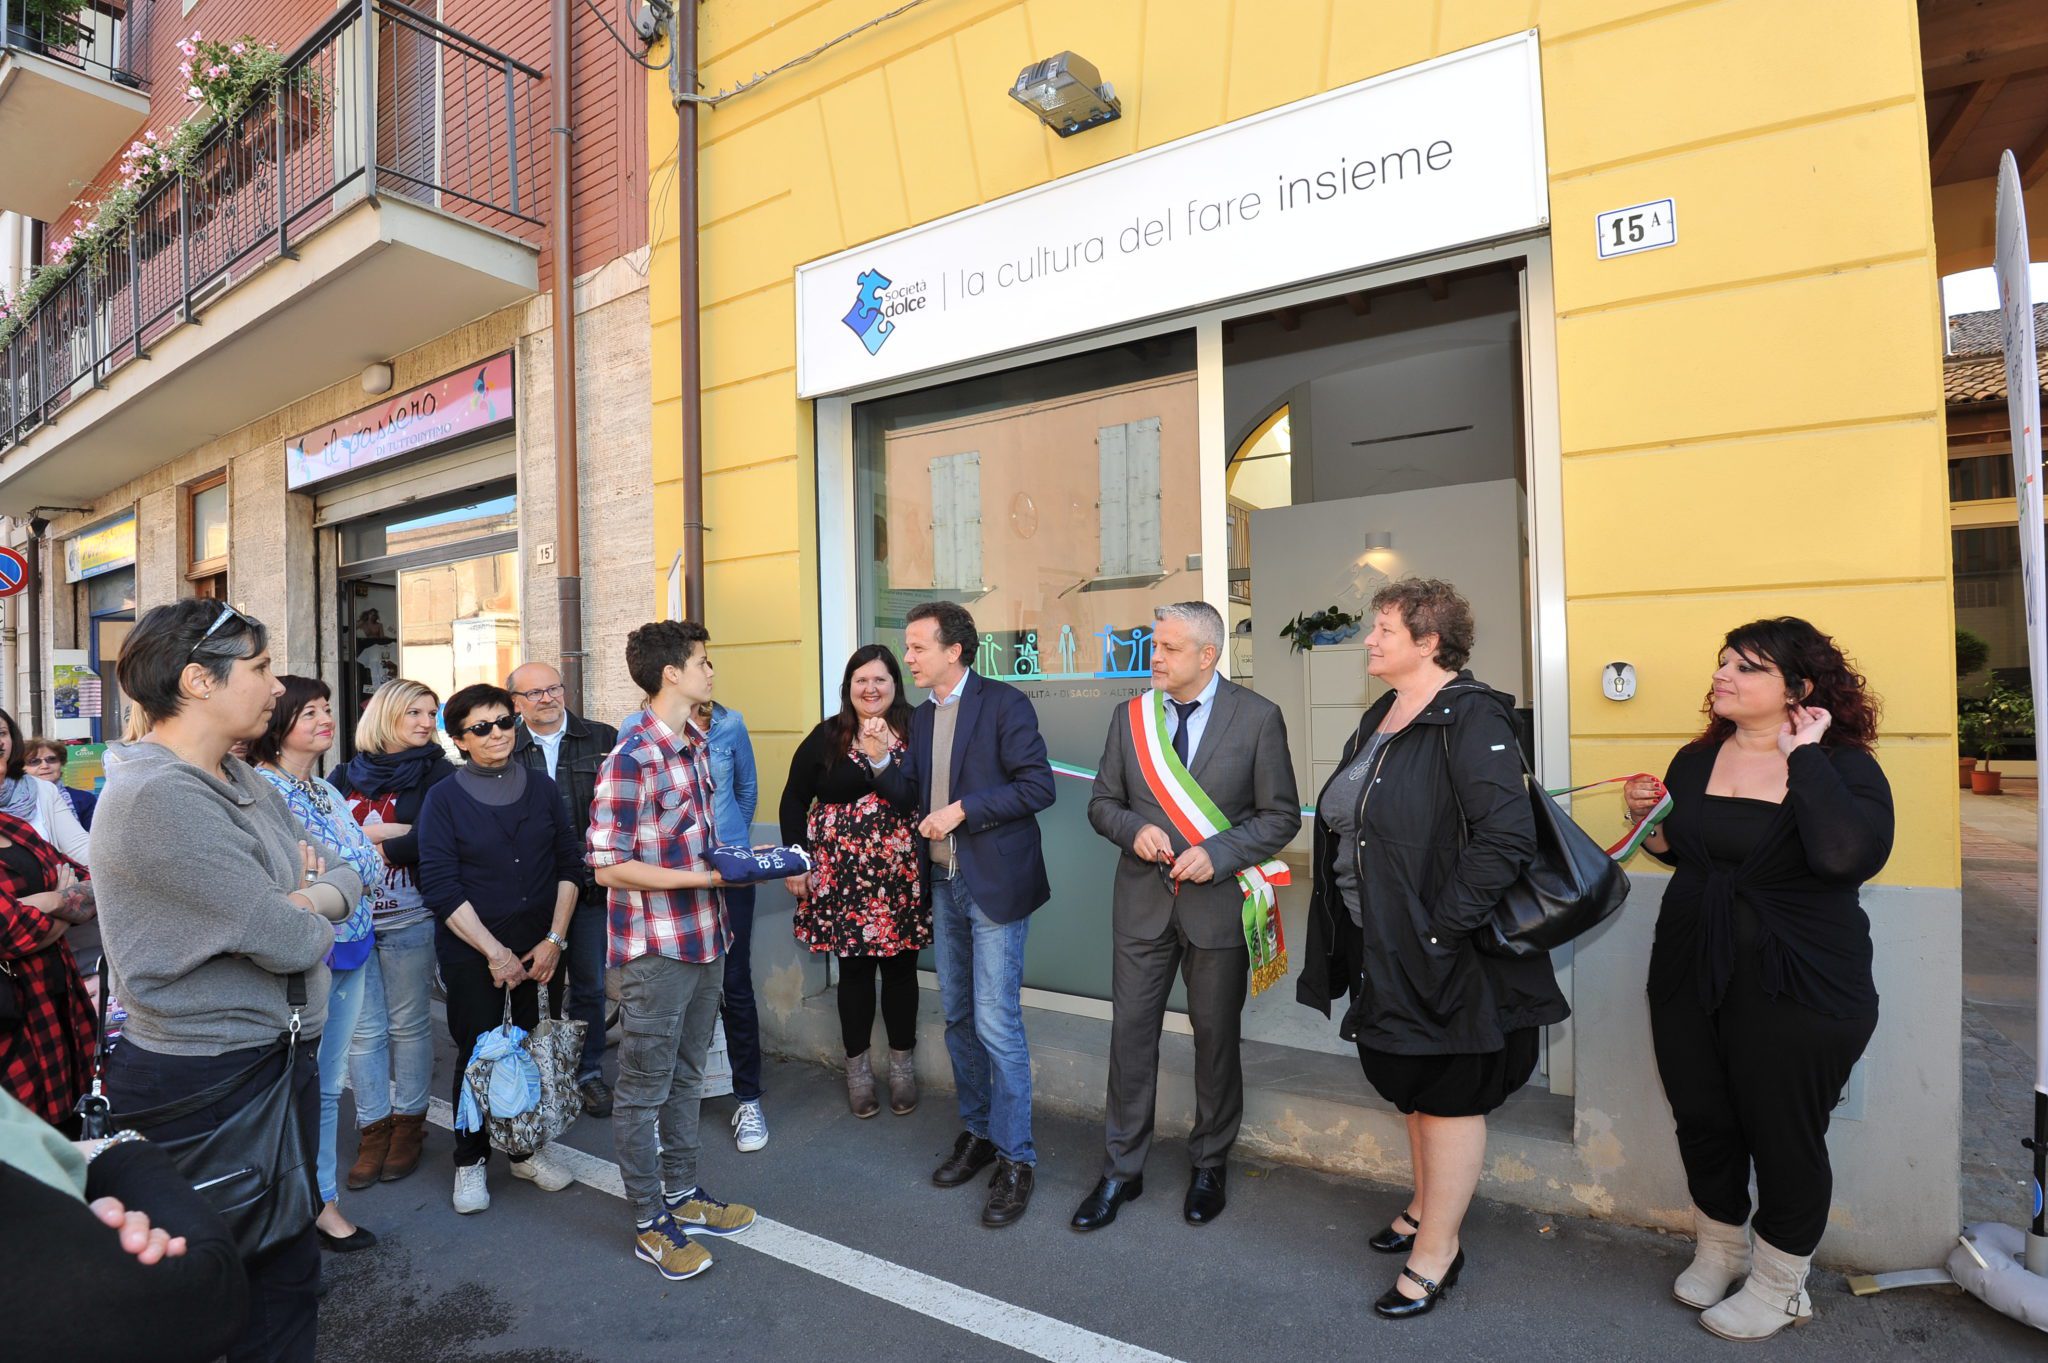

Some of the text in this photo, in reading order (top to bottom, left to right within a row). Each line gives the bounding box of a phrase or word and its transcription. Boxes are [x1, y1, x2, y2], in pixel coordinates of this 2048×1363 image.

[961, 140, 1453, 298] la cultura del fare insieme
[1612, 211, 1661, 247] 15 A
[885, 279, 927, 302] società
[885, 296, 926, 318] dolce
[342, 392, 436, 468] passero
[388, 422, 452, 452] TUTTOINTIMO
[374, 900, 398, 910] RIS
